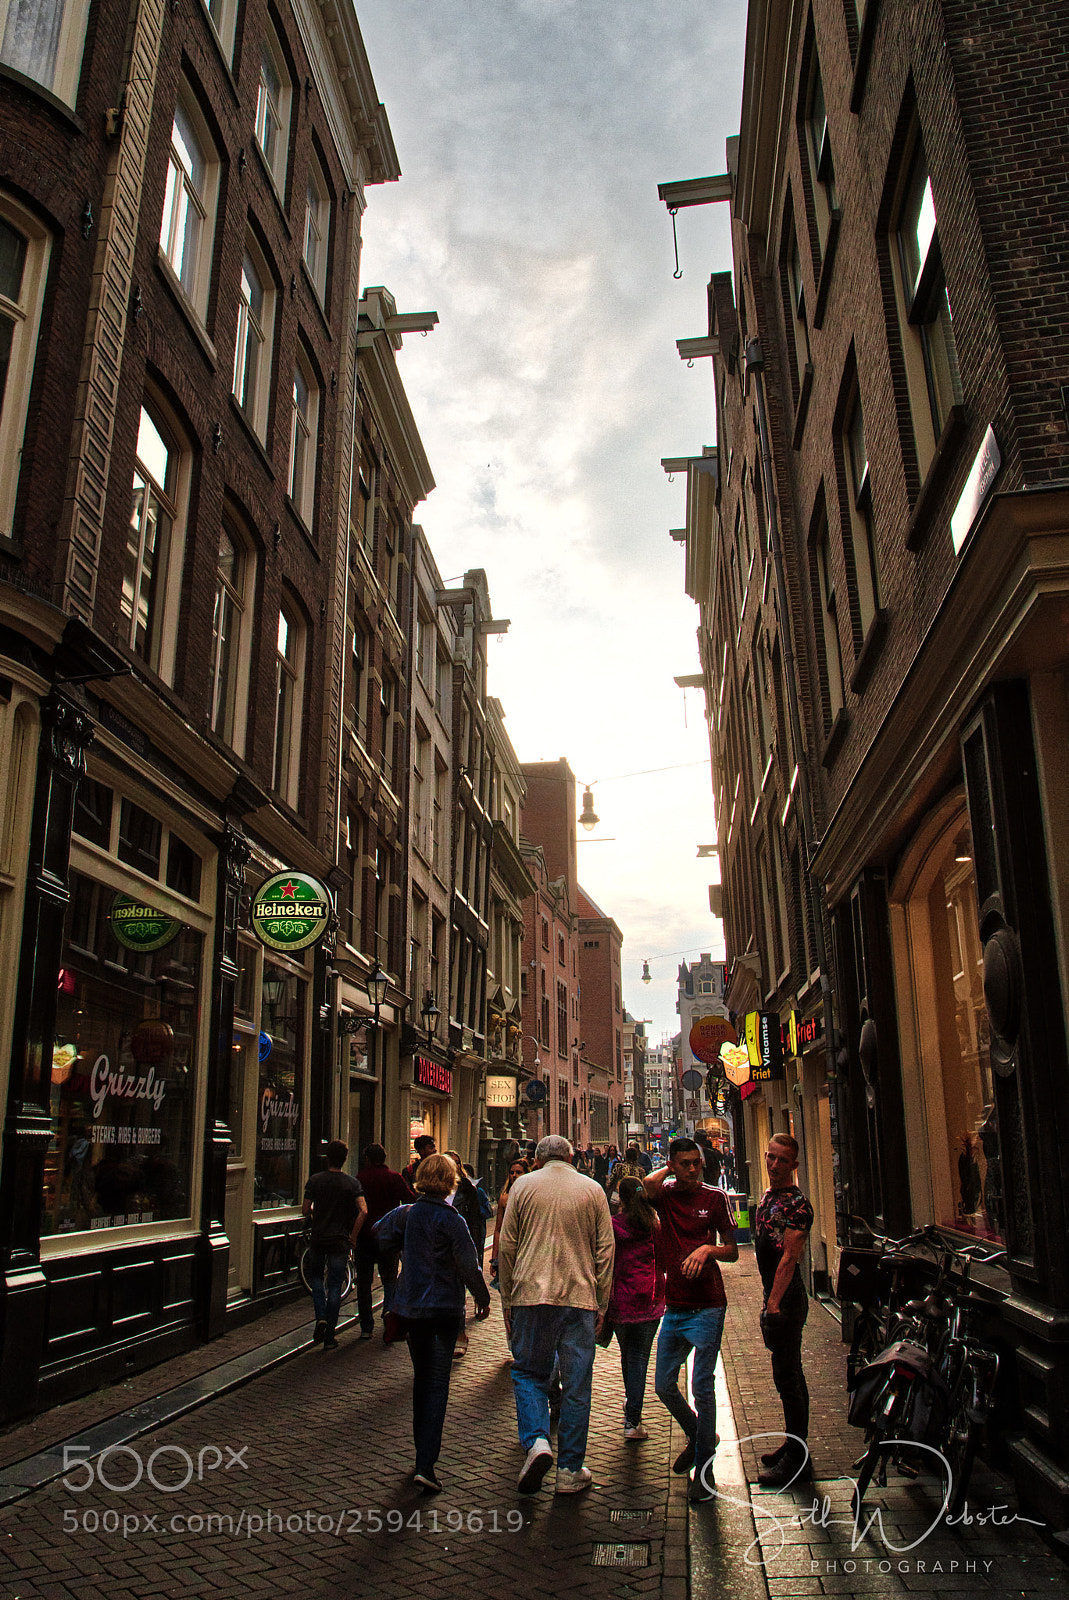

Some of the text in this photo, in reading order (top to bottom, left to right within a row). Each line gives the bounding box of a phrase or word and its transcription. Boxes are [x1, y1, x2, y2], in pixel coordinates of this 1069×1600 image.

[255, 902, 323, 917] Heineken
[761, 1016, 771, 1067] Vlaamse
[752, 1068, 771, 1080] Friet
[90, 1054, 166, 1119] Grizzly
[490, 1080, 511, 1089] SEX
[486, 1093, 515, 1103] SHOP
[261, 1087, 299, 1133] Grizzly
[91, 1125, 117, 1145] STEAKS,
[118, 1126, 132, 1143] RIBS
[137, 1127, 161, 1145] BURGERS
